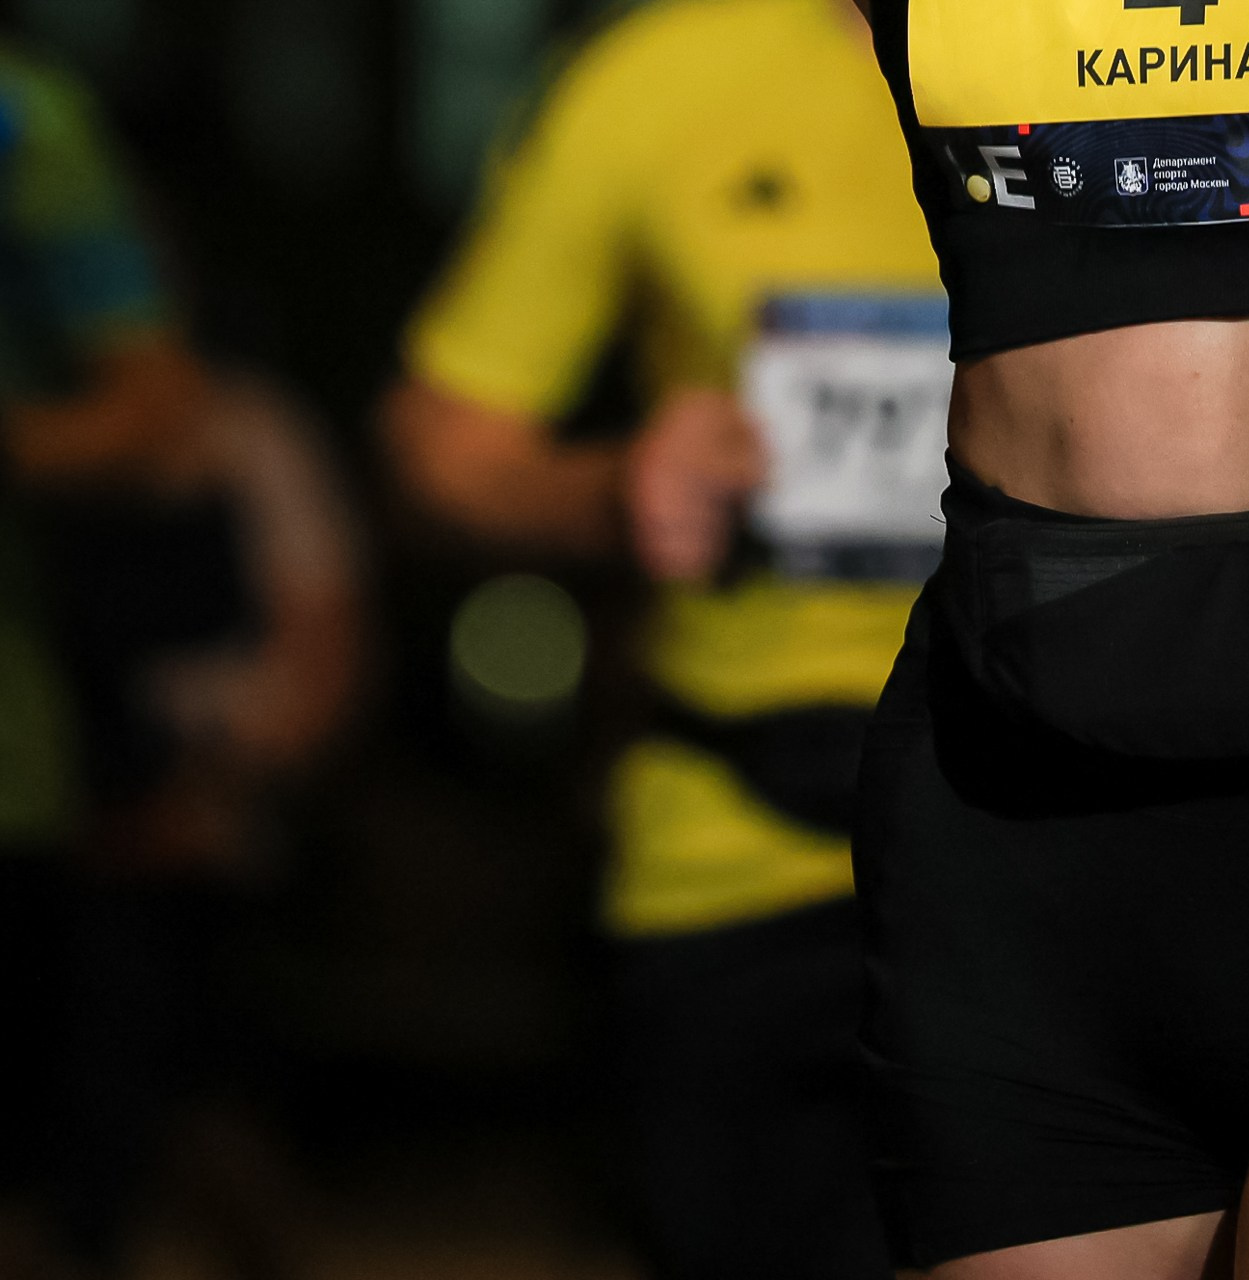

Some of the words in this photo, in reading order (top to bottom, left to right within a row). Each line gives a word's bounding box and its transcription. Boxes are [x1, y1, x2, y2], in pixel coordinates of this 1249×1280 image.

[1152, 156, 1217, 169] Департамент
[1153, 169, 1187, 180] спорта
[1154, 181, 1189, 192] города
[1190, 178, 1230, 190] Москвы
